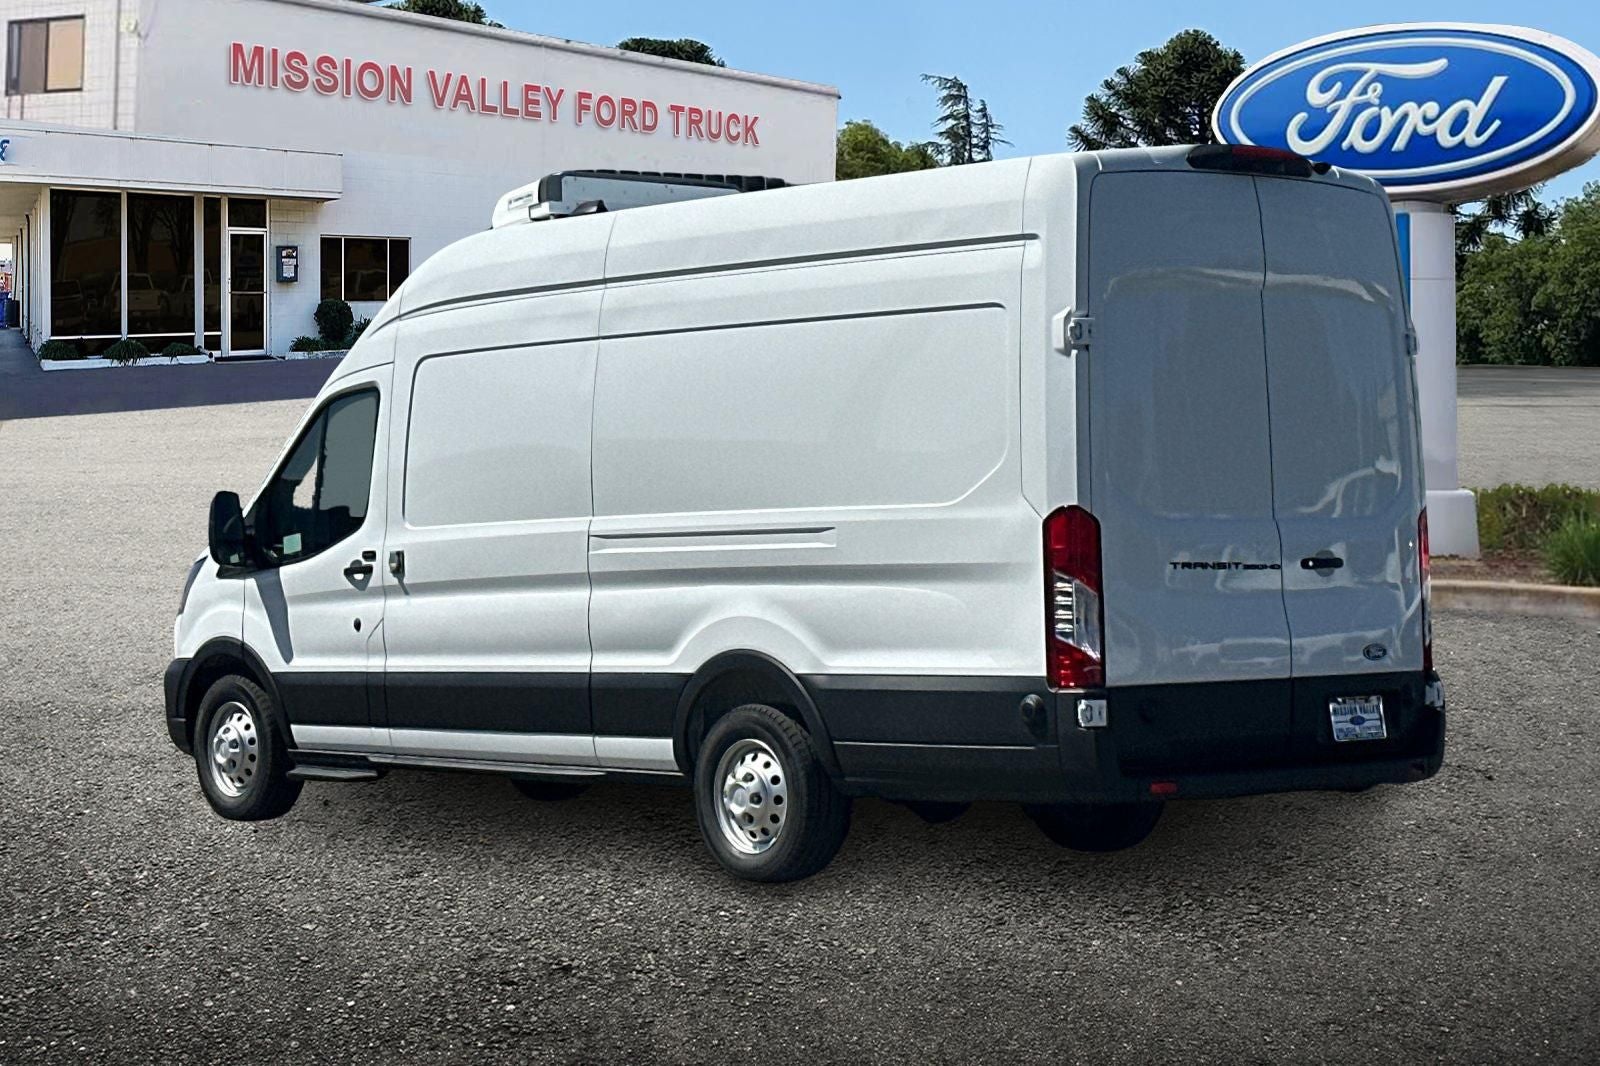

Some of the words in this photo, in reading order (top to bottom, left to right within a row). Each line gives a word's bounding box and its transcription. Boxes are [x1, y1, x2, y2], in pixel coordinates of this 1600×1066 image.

[230, 41, 413, 105] MISSION
[426, 69, 566, 122] VALLEY
[575, 90, 660, 134] FORD
[669, 103, 762, 147] TRUCK
[1286, 57, 1509, 156] Ford
[1168, 561, 1243, 571] TRANSIT
